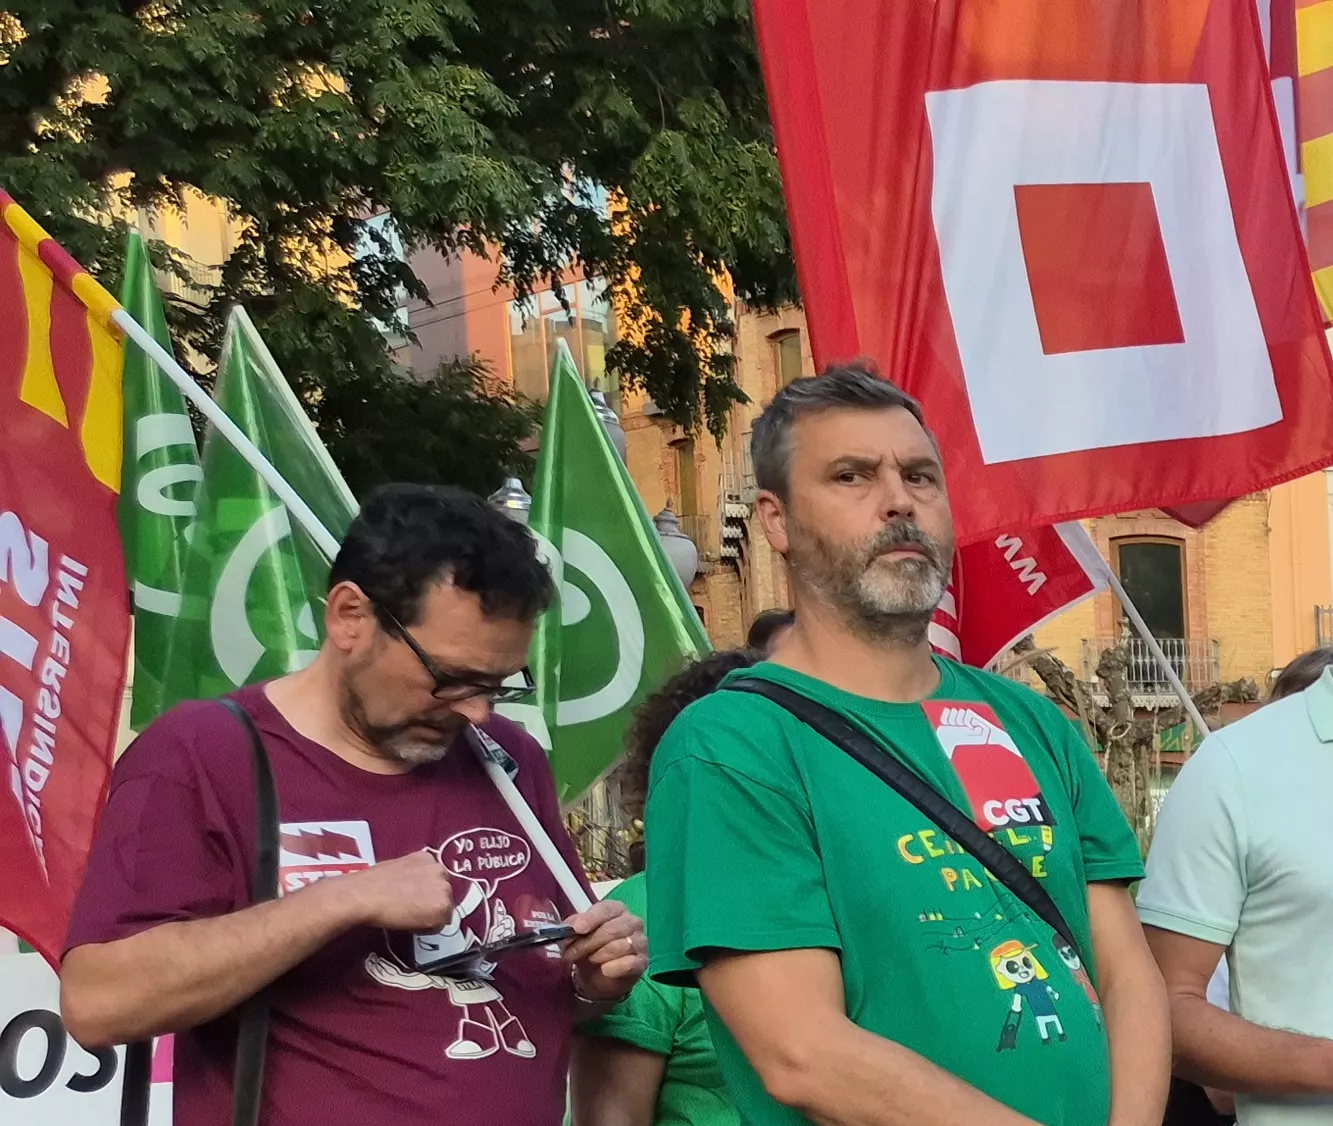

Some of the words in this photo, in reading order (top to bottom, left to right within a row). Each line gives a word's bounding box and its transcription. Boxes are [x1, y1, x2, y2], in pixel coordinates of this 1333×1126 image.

[983, 798, 1045, 826] CGT
[454, 837, 473, 854] YO
[480, 835, 511, 849] ELIJO
[453, 859, 472, 873] LA
[478, 852, 527, 871] PÚBLICA
